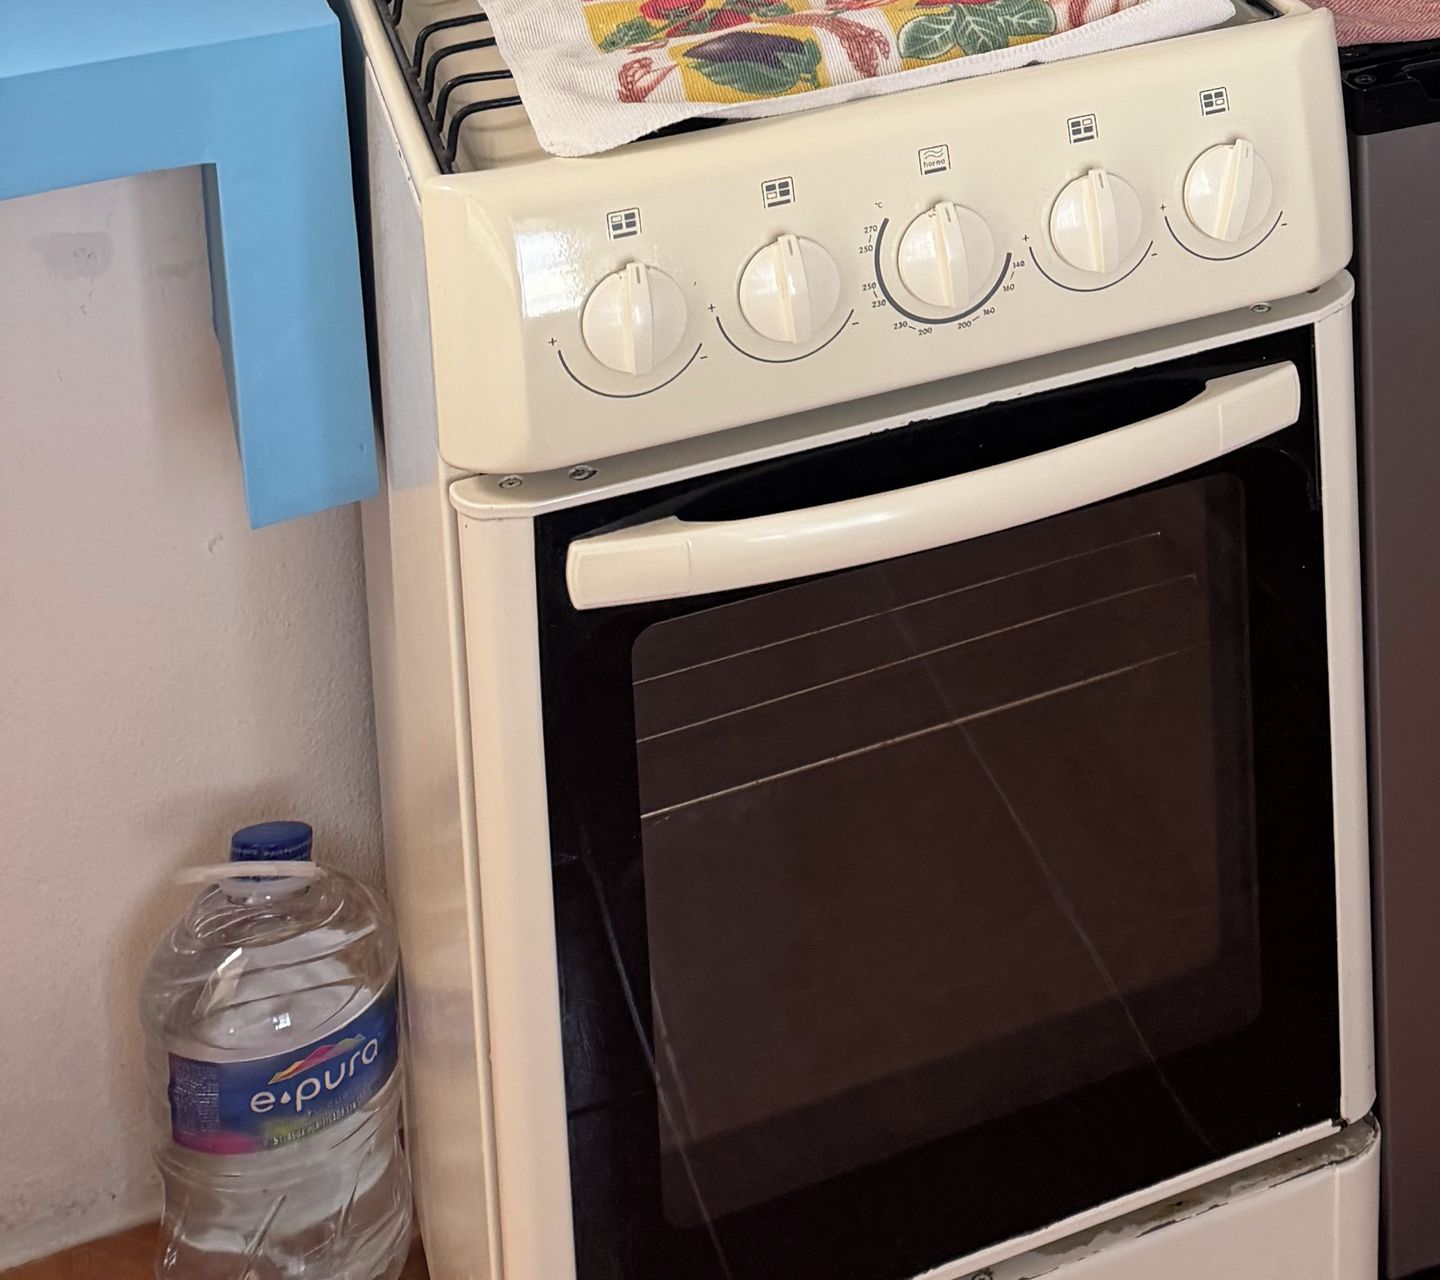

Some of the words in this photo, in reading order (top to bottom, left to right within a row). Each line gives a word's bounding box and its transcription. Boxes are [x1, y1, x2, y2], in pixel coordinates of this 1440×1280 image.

[923, 158, 946, 169] horno
[864, 225, 878, 234] 270
[858, 245, 874, 254] 250
[1012, 260, 1025, 269] 140
[862, 282, 877, 292] 250
[1002, 283, 1015, 293] 160
[871, 299, 886, 308] 230
[893, 320, 908, 330] 230
[957, 320, 972, 330] 200
[918, 327, 933, 336] 200
